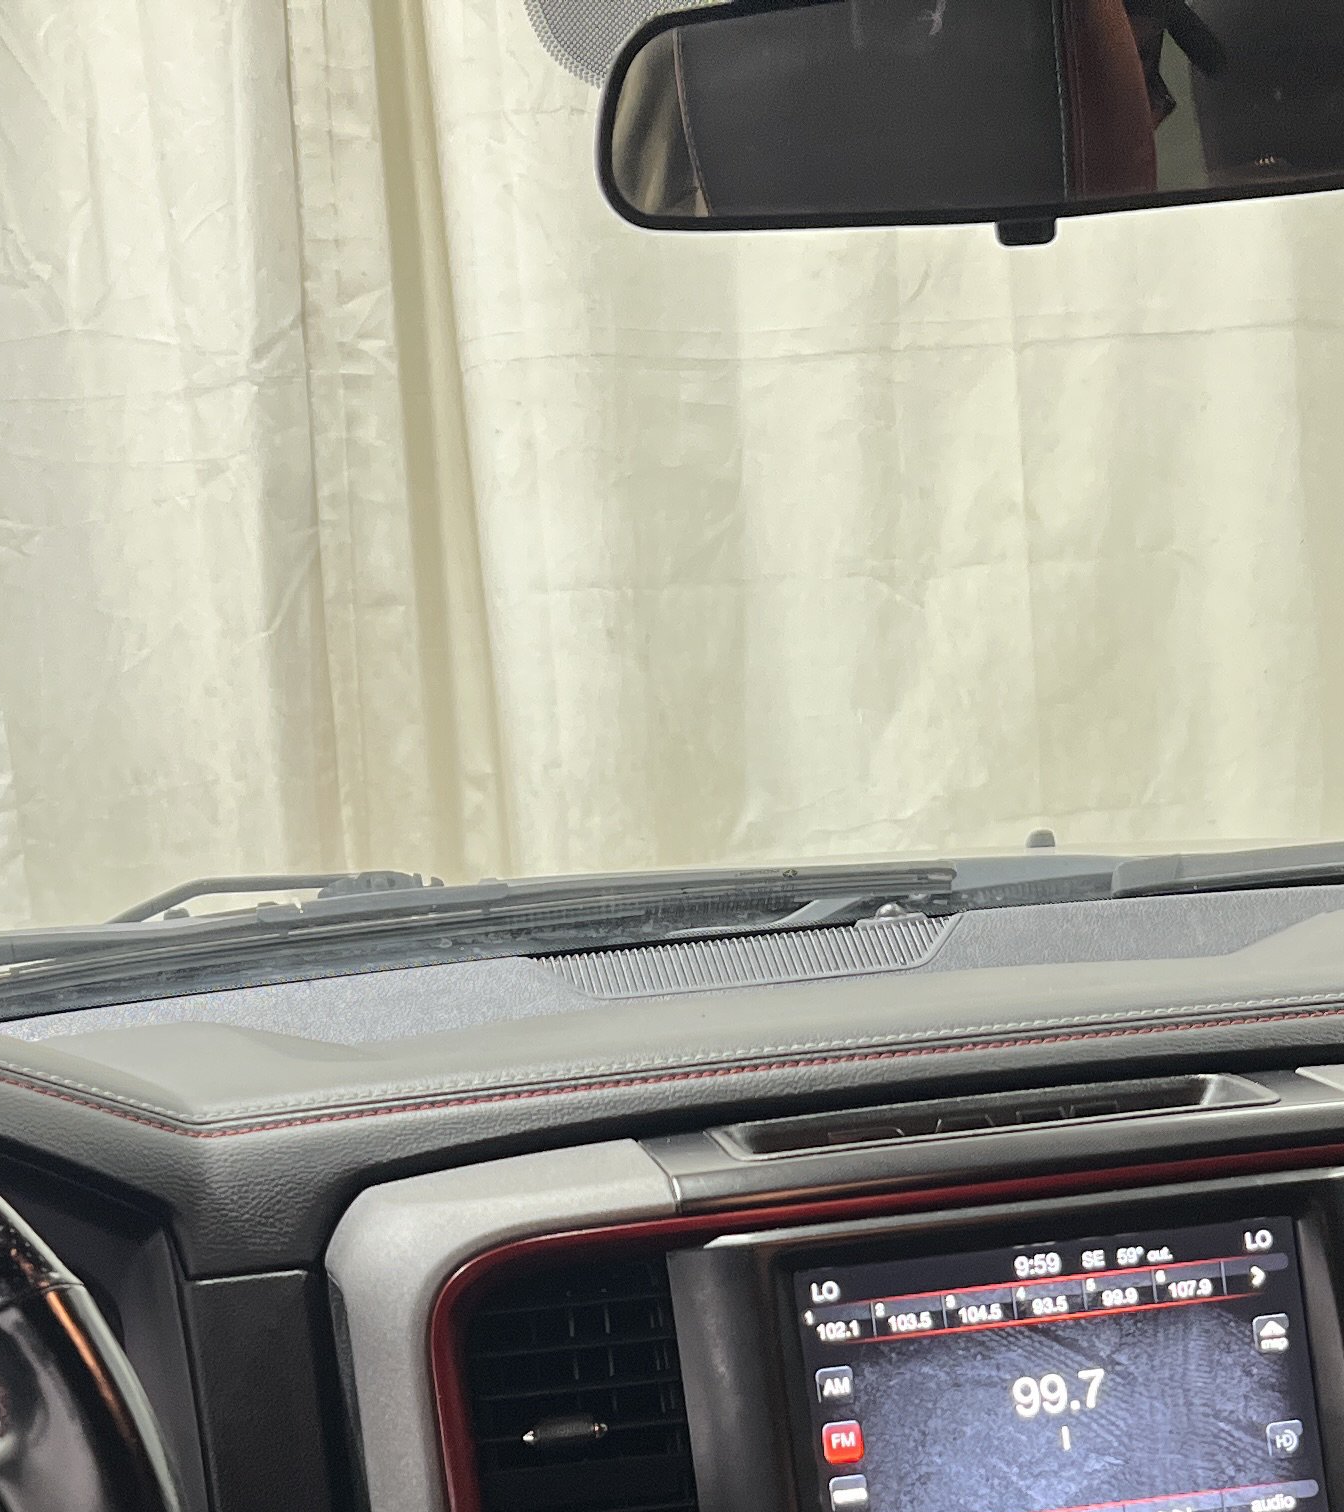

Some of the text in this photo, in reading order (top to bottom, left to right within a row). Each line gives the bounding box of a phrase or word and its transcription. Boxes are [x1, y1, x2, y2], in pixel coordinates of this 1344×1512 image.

[1244, 1229, 1273, 1251] LO
[1014, 1252, 1061, 1277] 9:59
[810, 1281, 840, 1302] LO
[1101, 1287, 1139, 1306] 99.9
[958, 1303, 1004, 1323] 104.5
[1032, 1295, 1069, 1315] 93.5
[816, 1321, 861, 1341] 102.1
[888, 1312, 934, 1332] 103.5
[823, 1377, 851, 1396] AM
[1013, 1368, 1105, 1418] 99.7
[831, 1432, 855, 1449] FM
